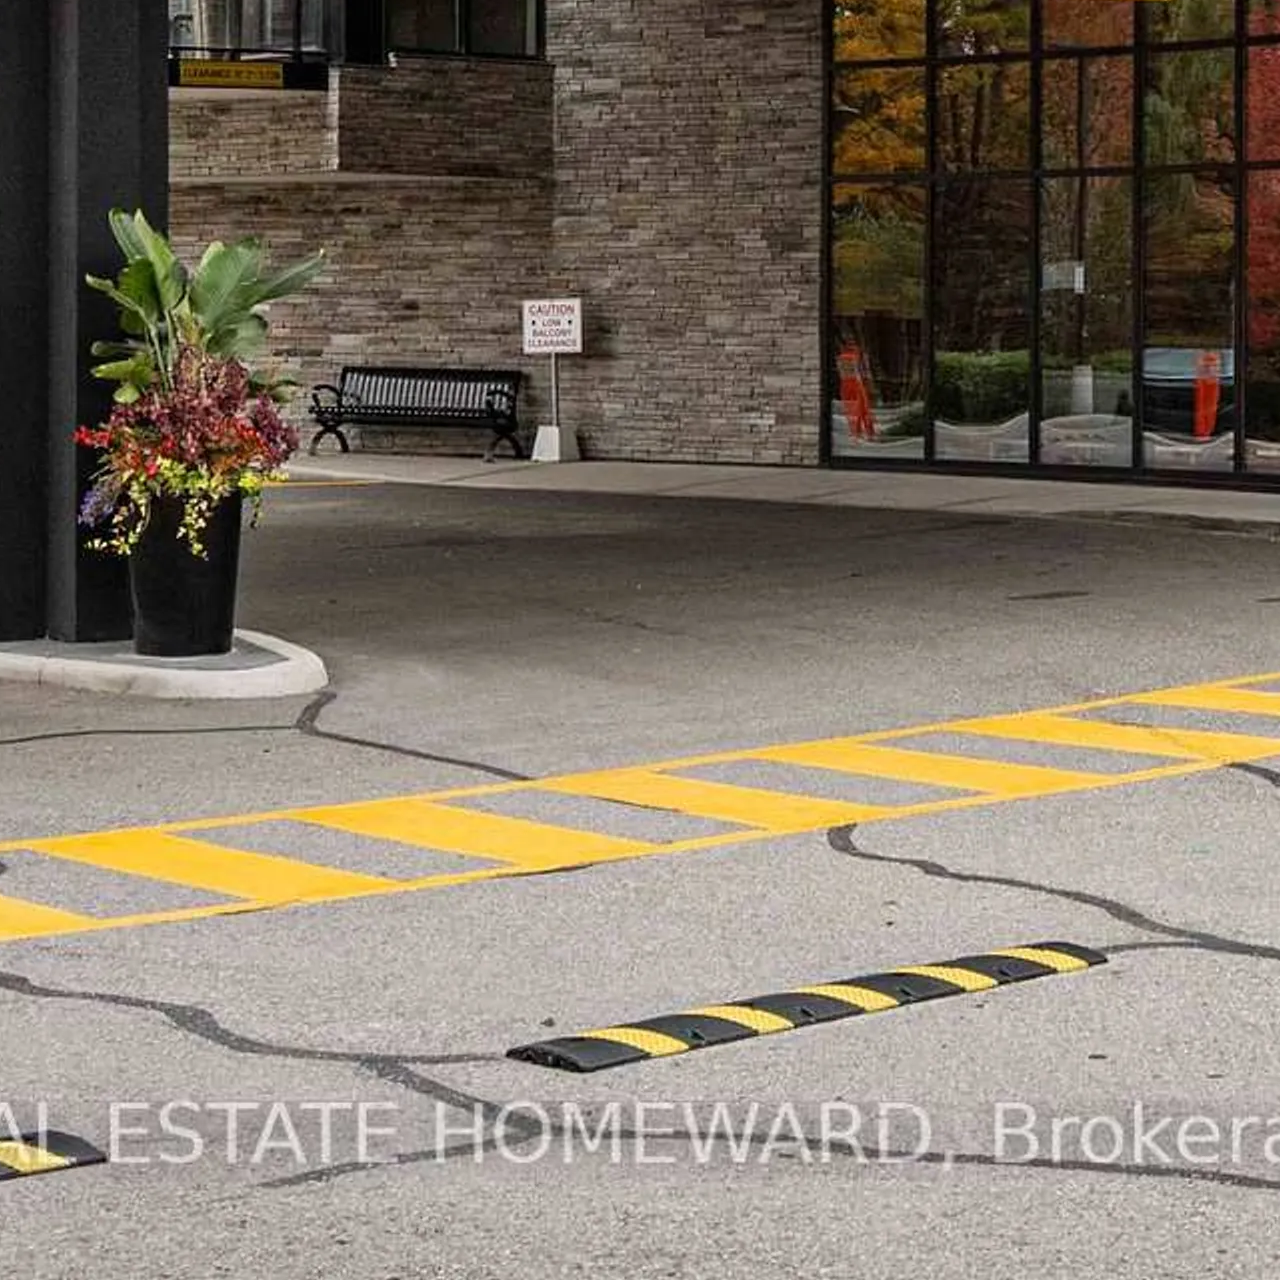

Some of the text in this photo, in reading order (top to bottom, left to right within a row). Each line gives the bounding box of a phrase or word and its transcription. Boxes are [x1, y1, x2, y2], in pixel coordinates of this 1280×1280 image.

[528, 303, 575, 315] CAUTION
[542, 318, 561, 327] LOW
[532, 327, 572, 337] BALCONY
[528, 338, 577, 348] CLEARANCE
